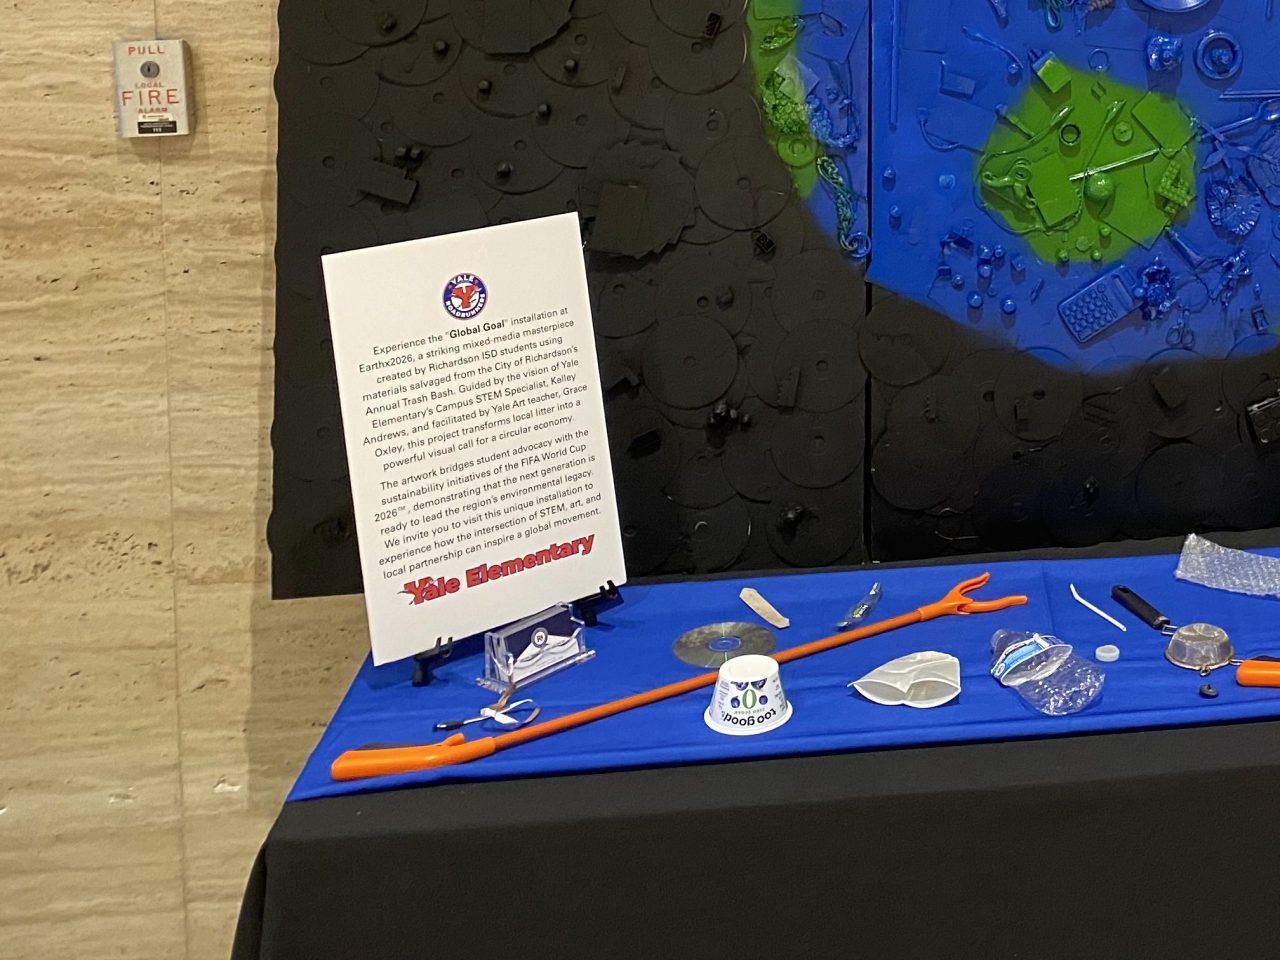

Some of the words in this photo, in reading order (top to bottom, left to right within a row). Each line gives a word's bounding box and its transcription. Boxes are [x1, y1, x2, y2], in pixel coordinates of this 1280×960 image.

[128, 45, 165, 55] PULL
[122, 89, 180, 106] FIRE
[450, 274, 475, 285] YALE
[445, 293, 486, 318] ROADRUNNERS
[359, 354, 415, 373] Earthx2026,
[426, 345, 460, 358] striking
[462, 332, 520, 350] mixed-media
[522, 320, 574, 336] masterpiece
[373, 339, 426, 355] Experience
[428, 335, 443, 343] the
[511, 311, 557, 325] installation
[560, 307, 568, 315] at
[362, 385, 407, 401] materials
[409, 374, 451, 391] salvaged
[453, 370, 476, 380] from
[478, 366, 492, 375] the
[494, 362, 512, 371] City
[514, 357, 523, 366] of
[376, 369, 412, 384] created
[414, 367, 426, 375] by
[428, 355, 480, 372] Richardson
[482, 349, 498, 360] ISD
[500, 342, 537, 356] students
[539, 336, 563, 347] using
[365, 400, 400, 416] Annual
[401, 394, 428, 406] Trash
[430, 388, 455, 400] Bash.
[458, 378, 491, 393] Guided
[493, 377, 504, 385] by
[507, 373, 521, 382] the
[523, 367, 549, 378] vision
[551, 362, 559, 371] of
[561, 359, 579, 369] Yale
[436, 399, 474, 413] Campus
[476, 389, 502, 404] STEM
[504, 380, 549, 397] Specialist,
[551, 374, 576, 385] Kelley
[363, 429, 409, 446] Andrews,
[412, 421, 429, 434] and
[432, 410, 477, 428] facilitated
[479, 409, 490, 417] by
[491, 403, 510, 413] Yale
[512, 399, 526, 409] Art
[527, 392, 561, 404] teacher,
[563, 385, 587, 396] Grace
[374, 445, 405, 457] Oxley,
[407, 439, 425, 449] this
[427, 430, 459, 446] project
[461, 417, 511, 435] transforms
[513, 410, 533, 422] local
[535, 406, 555, 416] litter
[557, 402, 574, 411] into
[383, 451, 426, 472] powerful
[428, 444, 455, 458] visual
[458, 439, 474, 451] call
[476, 437, 489, 445] for
[499, 426, 531, 440] circular
[533, 416, 574, 431] economy.
[399, 576, 461, 605] Yale
[465, 534, 595, 588] Elementary
[723, 713, 755, 726] good
[757, 708, 777, 723] too
